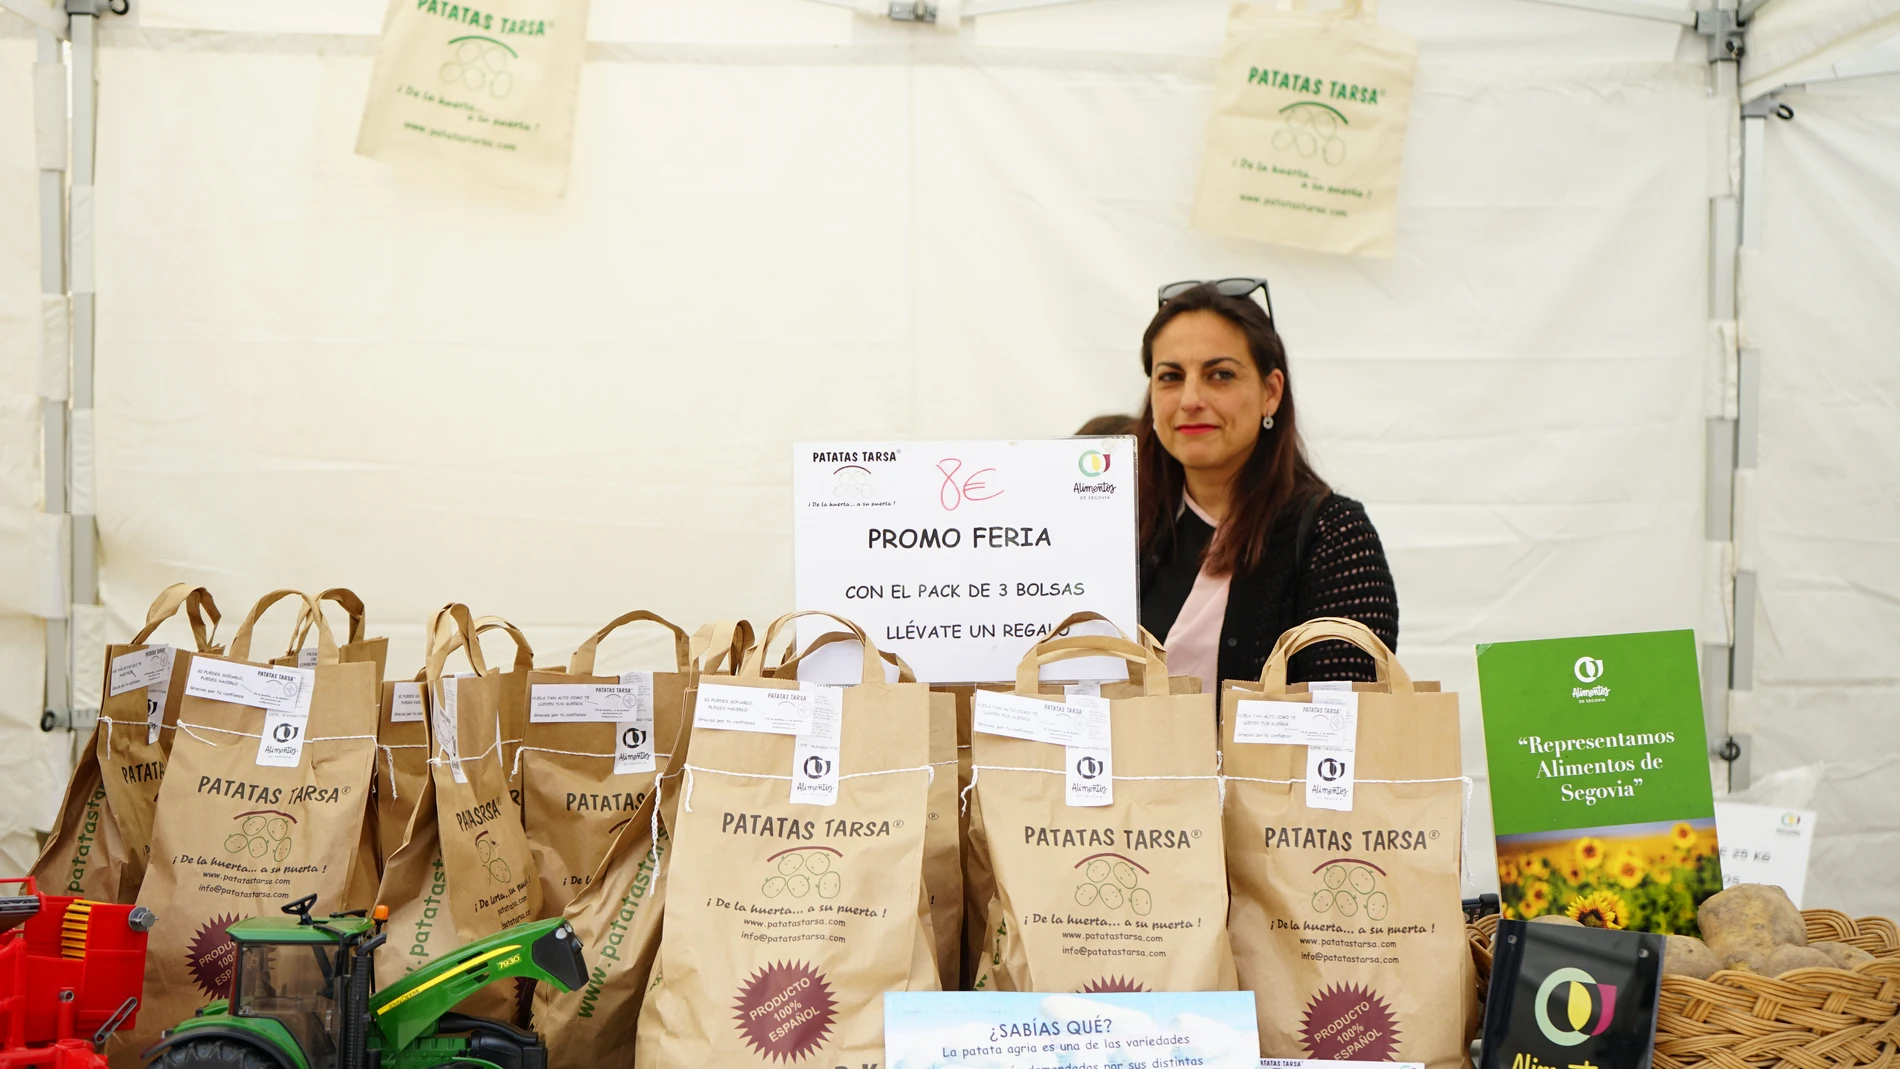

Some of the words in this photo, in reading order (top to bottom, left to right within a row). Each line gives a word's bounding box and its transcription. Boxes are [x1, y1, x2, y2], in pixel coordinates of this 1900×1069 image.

[417, 0, 494, 30] PATATAS
[500, 18, 545, 36] TARSA
[1248, 66, 1323, 95] PATATAS
[1329, 81, 1379, 104] TARSA
[813, 452, 858, 462] PATATAS
[863, 452, 896, 462] TARSA
[936, 458, 1004, 511] 8€
[1073, 482, 1117, 494] Alimentos
[869, 528, 961, 549] PROMO
[973, 527, 1051, 548] FERIA
[846, 584, 884, 599] CON
[891, 585, 910, 598] EL
[918, 584, 961, 598] PACK
[968, 584, 991, 598] DE
[999, 584, 1008, 597] 3
[1016, 583, 1085, 597] BOLSAS
[886, 620, 962, 640] LLÉVATE
[970, 624, 995, 638] UN
[258, 670, 278, 679] PATATAS
[278, 674, 294, 682] TARSA
[767, 692, 789, 700] PATATAS
[790, 694, 807, 702] TARSA
[1572, 685, 1611, 698] Alimentos
[1044, 704, 1064, 712] PATATAS
[1066, 706, 1082, 715] TARSA
[264, 745, 298, 755] Alimentos
[1518, 731, 1675, 758] “Representamos
[619, 752, 651, 762] Alimentos
[1536, 759, 1634, 778] Alimentos
[1640, 752, 1663, 770] de
[198, 776, 282, 804] PATATAS
[797, 782, 833, 793] Alimentos
[1072, 782, 1108, 794] Alimentos
[1312, 784, 1349, 796] Alimentos
[1562, 778, 1642, 806] Segovia”
[566, 793, 645, 812] PATATAS
[722, 812, 815, 840] PATATAS
[1024, 826, 1115, 847] PATATAS
[1265, 827, 1352, 852] PATATAS
[1720, 847, 1728, 856] E
[1732, 848, 1748, 858] 25
[1754, 851, 1772, 862] KG
[180, 854, 194, 864] De
[196, 856, 207, 866] la
[211, 858, 256, 873] huerta...
[284, 864, 318, 874] puerta
[203, 871, 290, 885] www.patatastarsa.com
[199, 884, 289, 899] info@patatastarsa.com
[716, 898, 730, 909] De
[734, 901, 746, 912] la
[750, 904, 803, 915] huerta...
[819, 904, 833, 912] su
[837, 904, 878, 917] puerta
[743, 918, 846, 928] www.patatastarsa.com
[1032, 914, 1048, 924] De
[1051, 914, 1063, 924] la
[1067, 914, 1120, 926] huerta...
[1136, 920, 1148, 928] su
[1152, 919, 1194, 930] puerta
[1277, 919, 1288, 930] De
[1290, 920, 1300, 930] la
[1304, 921, 1354, 934] huerta...
[1388, 924, 1427, 935] puerta
[741, 931, 846, 944] info@patatastarsa.com
[1062, 931, 1164, 942] www.patatastarsa.com
[1300, 938, 1396, 948] www.patatastarsa.com
[1062, 946, 1166, 958] info@patatastarsa.com
[1301, 952, 1400, 964] info@patatastarsa.com
[498, 956, 520, 969] 7930
[749, 977, 810, 1021] PRODUCTO
[773, 1000, 802, 1022] 100%
[768, 1004, 820, 1042] ESPAÑOL
[990, 1018, 1060, 1042] ¿SABÍAS
[1067, 1014, 1112, 1034] QUÉ?
[1314, 1001, 1370, 1042] PRODUCTO
[1336, 1022, 1364, 1044] 100%
[942, 1046, 958, 1057] La
[962, 1045, 1002, 1058] patata
[1008, 1043, 1037, 1056] agria
[1042, 1044, 1055, 1052] es
[1060, 1043, 1080, 1051] una
[1086, 1040, 1099, 1050] de
[1104, 1038, 1121, 1048] las
[1126, 1035, 1190, 1048] variedades
[1334, 1028, 1382, 1060] ESPAÑOL
[1128, 1060, 1146, 1069] sus
[1152, 1056, 1204, 1068] distintas
